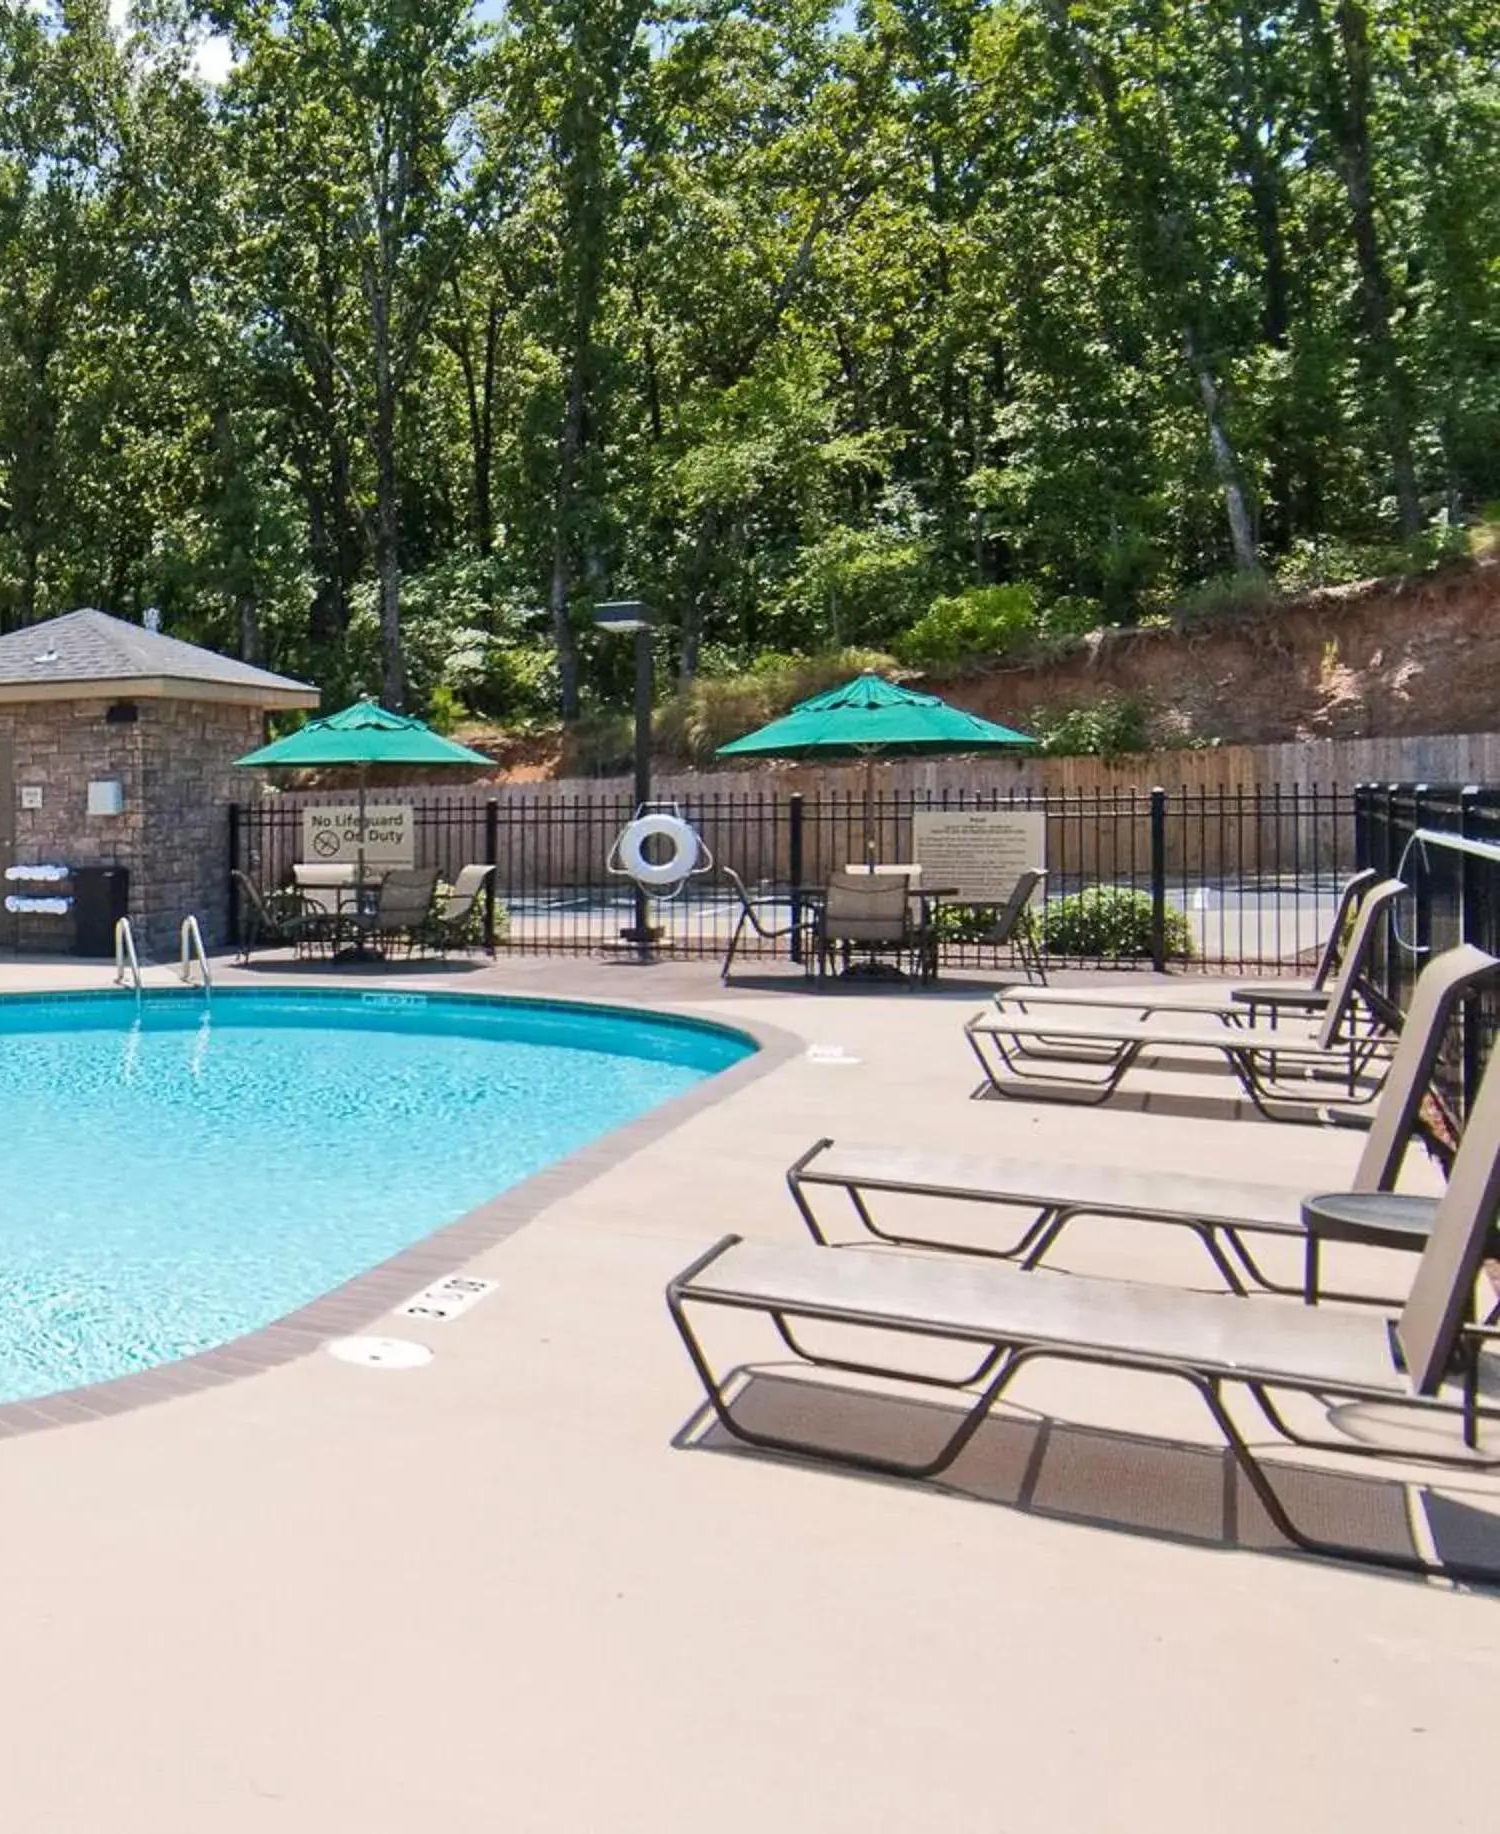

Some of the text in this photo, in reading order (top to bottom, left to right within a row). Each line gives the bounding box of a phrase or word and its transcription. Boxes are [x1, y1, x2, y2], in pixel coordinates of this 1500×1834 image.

[311, 813, 404, 829] No Lifeuard
[369, 829, 404, 845] Duty
